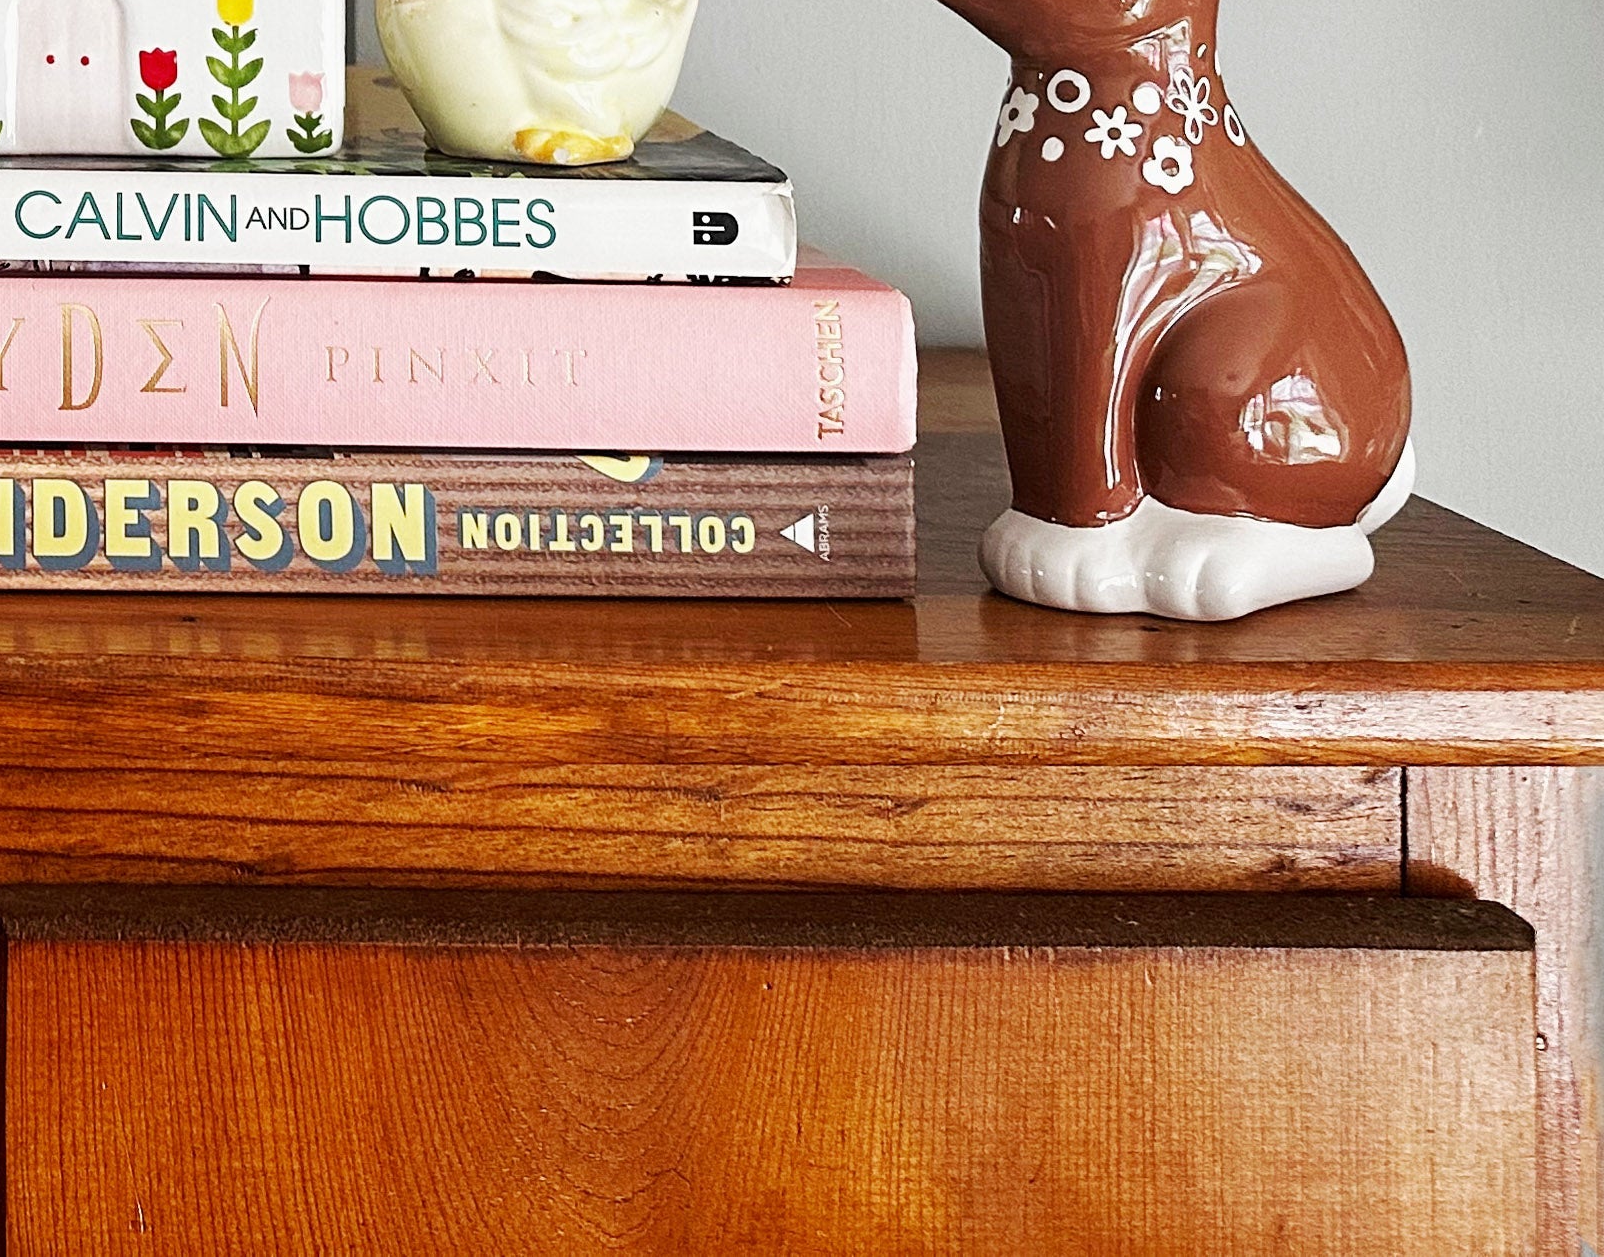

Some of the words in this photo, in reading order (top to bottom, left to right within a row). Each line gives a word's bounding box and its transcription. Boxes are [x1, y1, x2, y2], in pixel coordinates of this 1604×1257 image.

[15, 190, 237, 242] CALVIN
[245, 206, 310, 231] AND
[314, 194, 557, 247] HOBBES
[325, 345, 589, 387] PINXIT
[813, 299, 845, 440] TASCHEN
[457, 507, 756, 554] COLLECTION
[818, 504, 830, 562] ABRAMS
